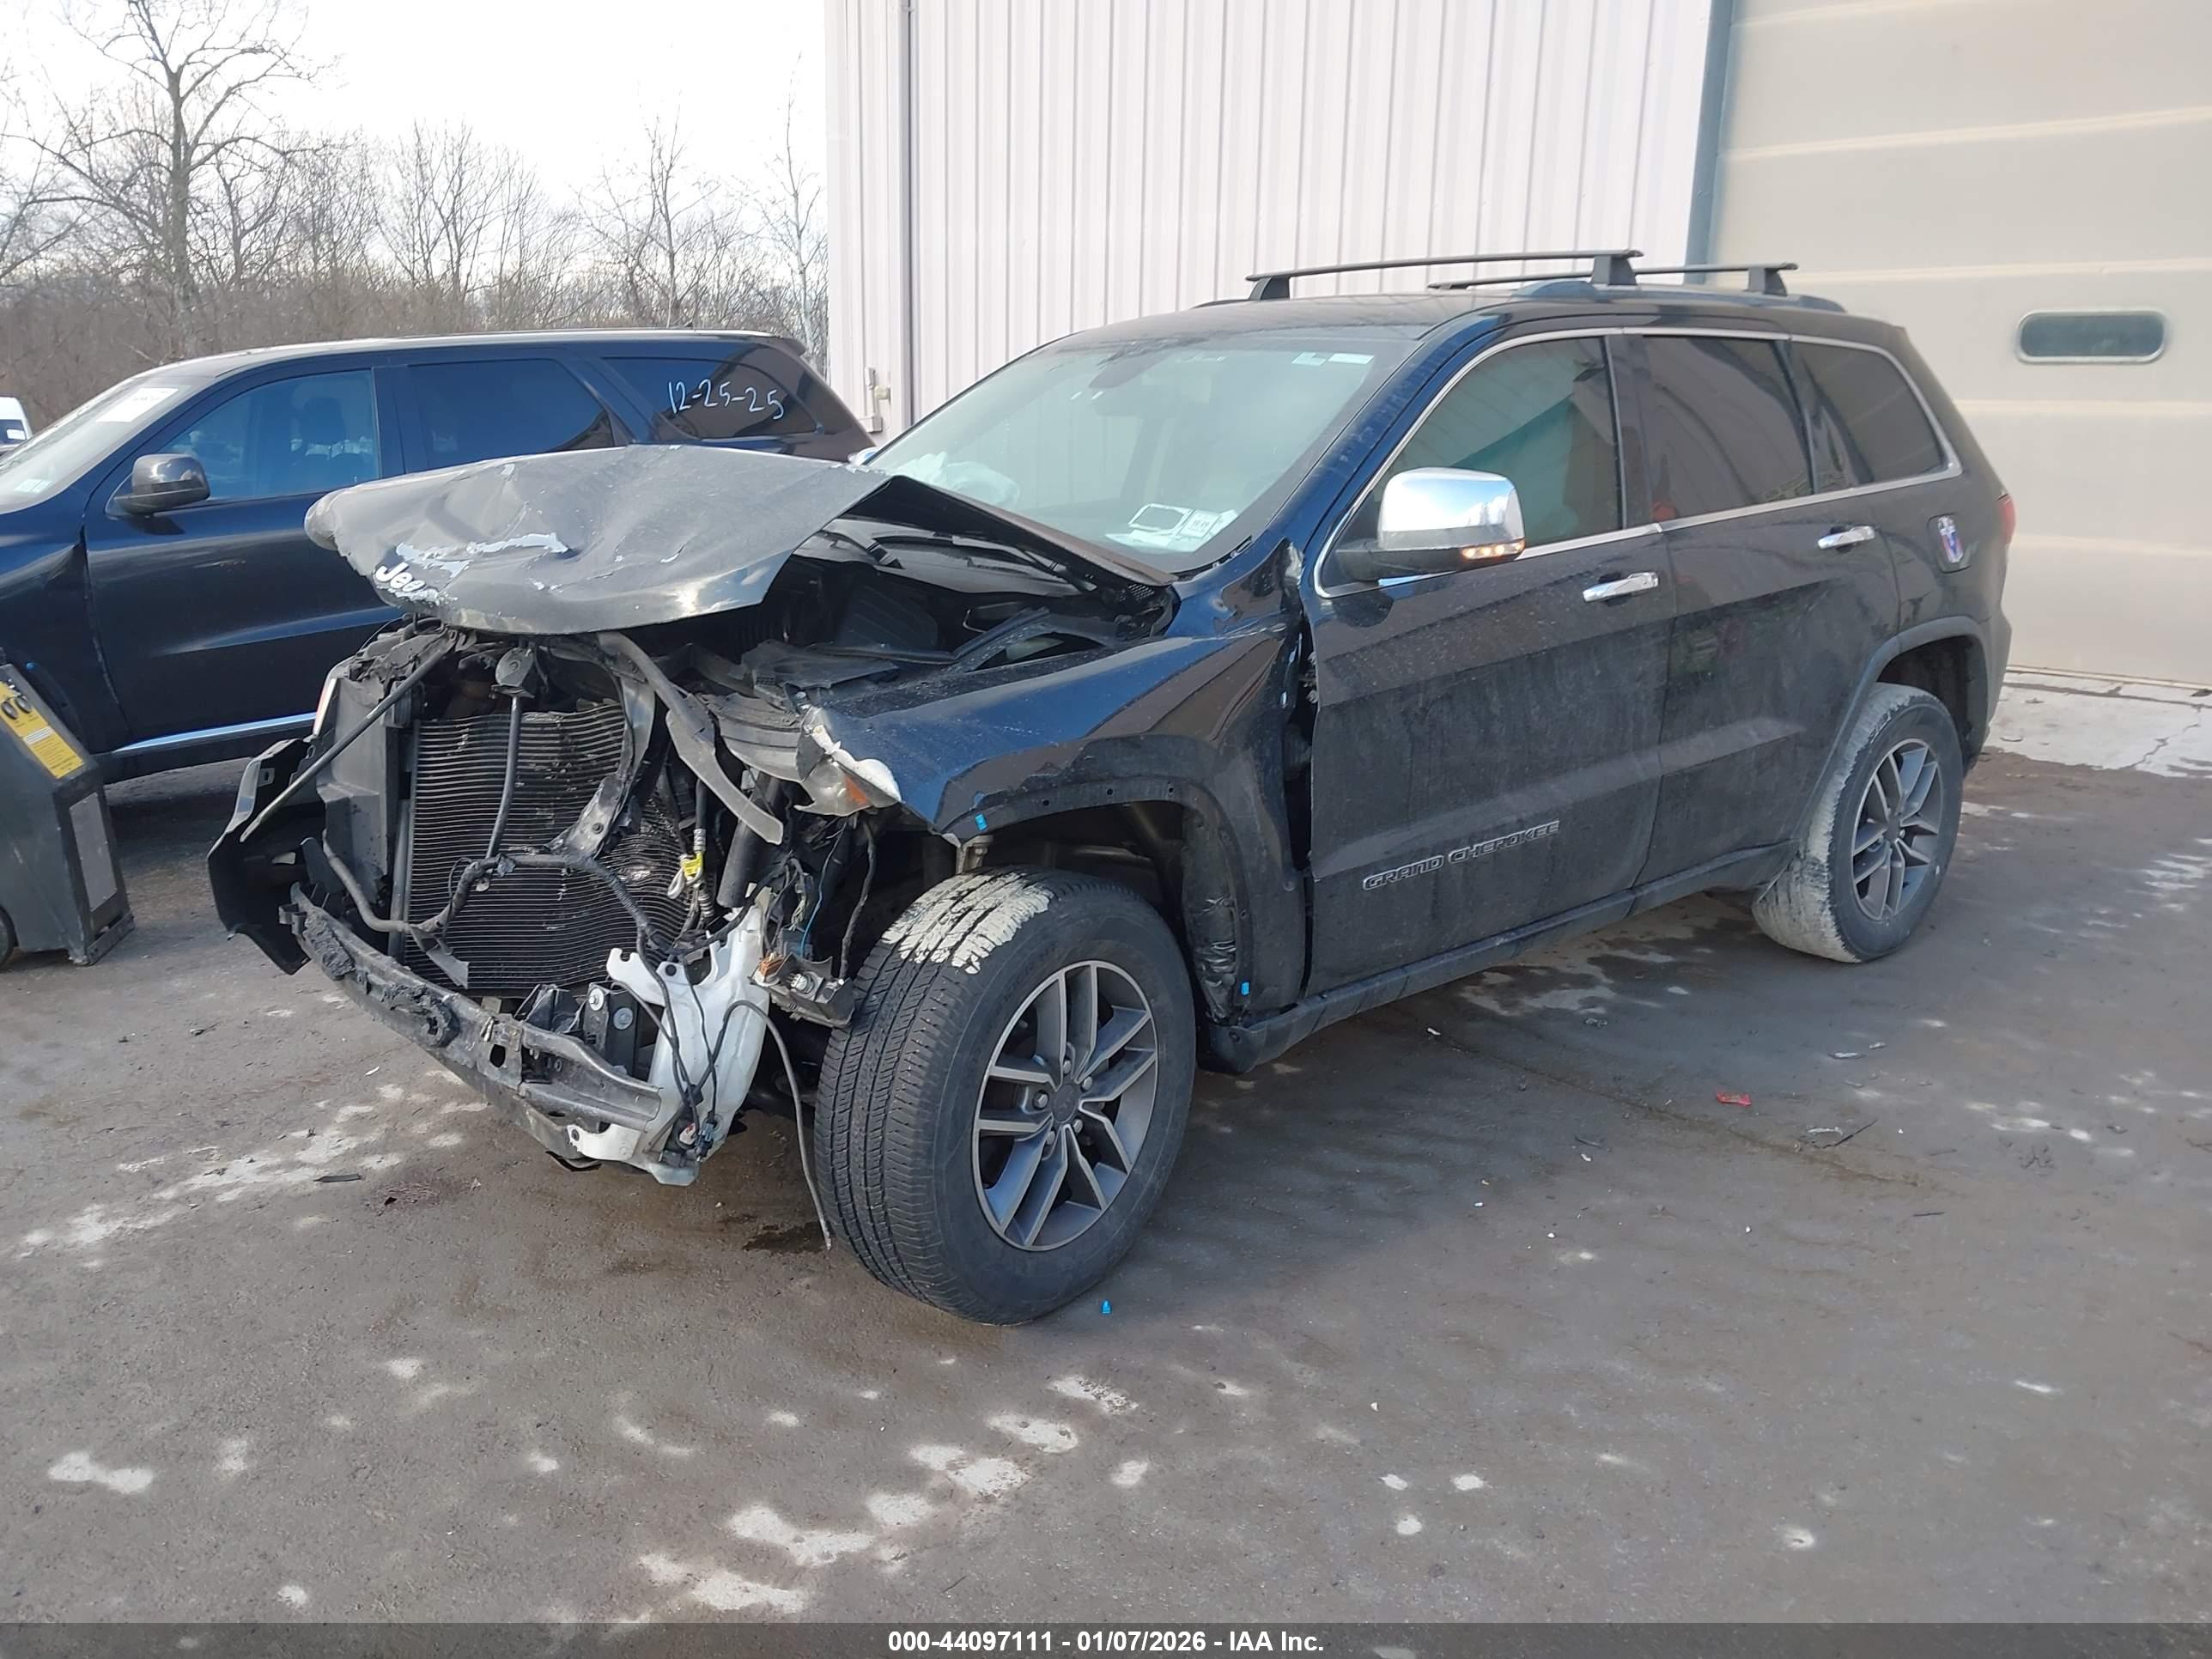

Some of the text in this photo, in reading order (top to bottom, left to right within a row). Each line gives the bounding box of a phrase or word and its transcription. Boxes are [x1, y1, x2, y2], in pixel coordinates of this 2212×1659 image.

[668, 379, 784, 420] 12-25-25
[375, 562, 426, 592] Jee
[1363, 819, 1560, 890] GRAND CHEROKEE
